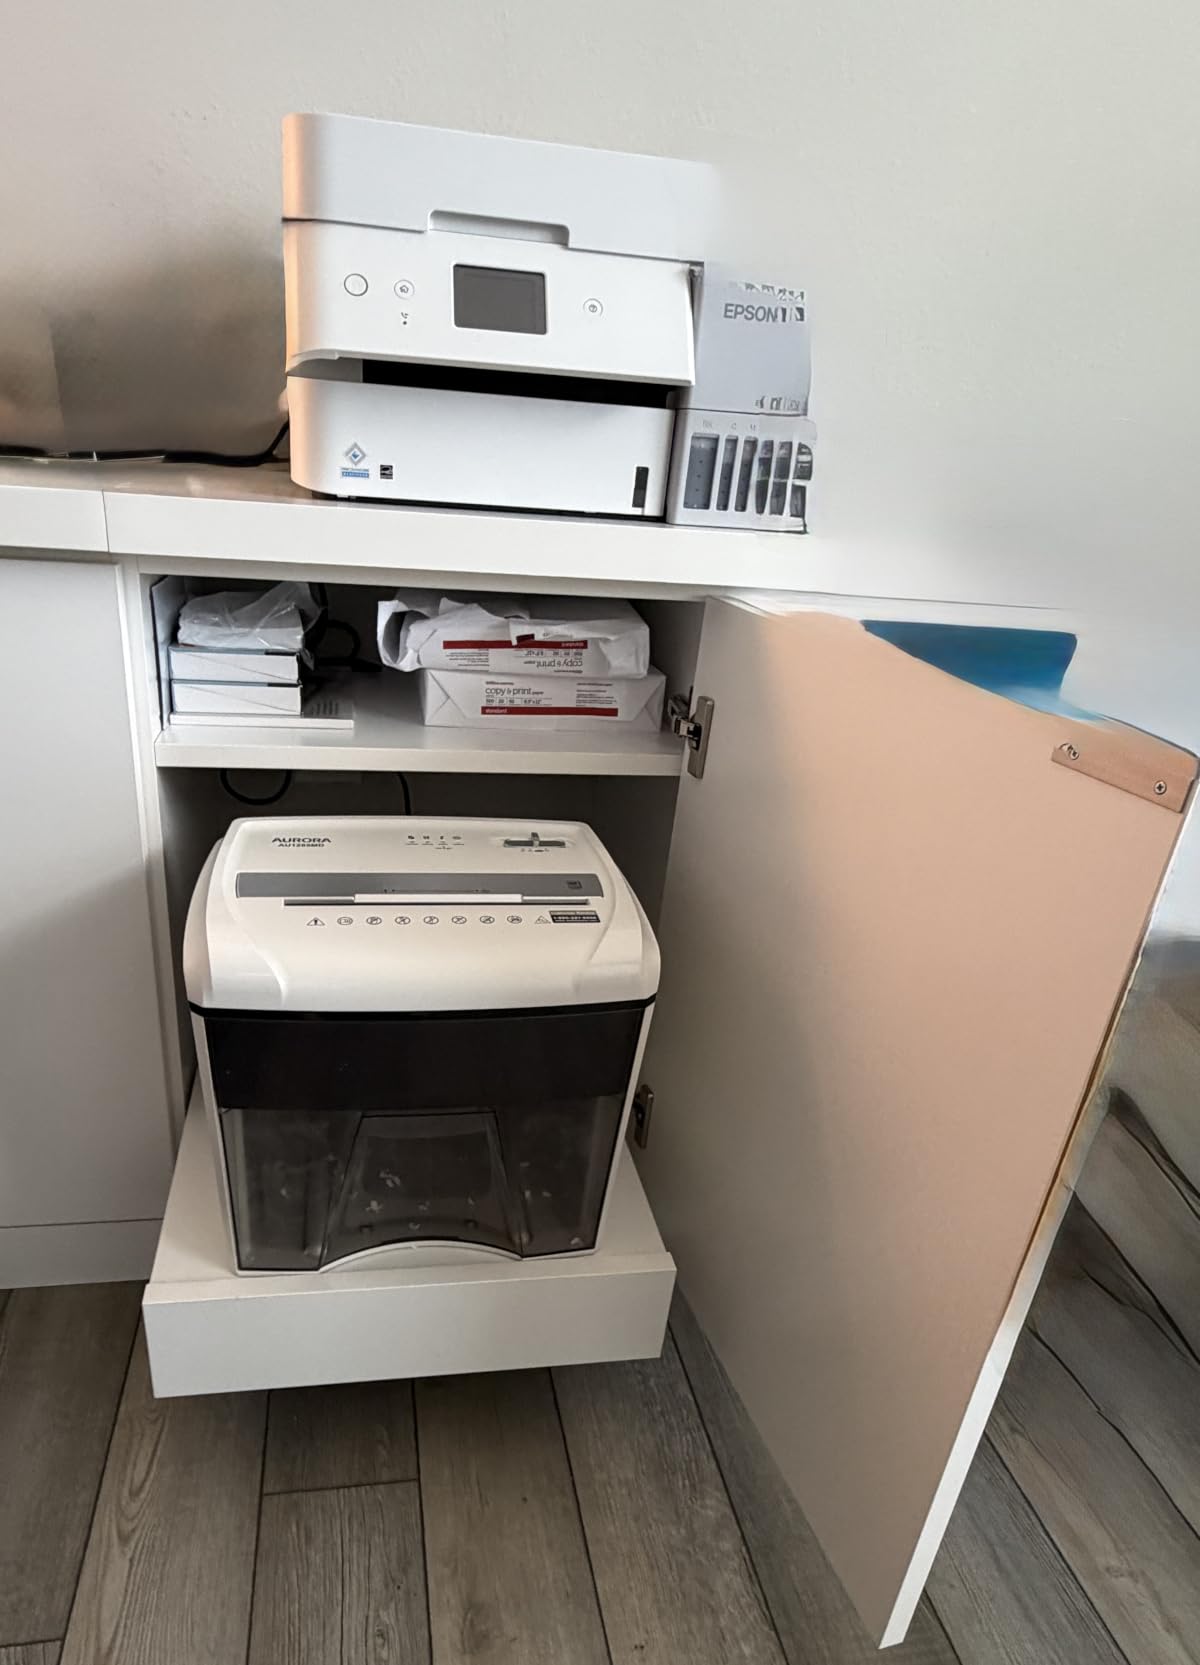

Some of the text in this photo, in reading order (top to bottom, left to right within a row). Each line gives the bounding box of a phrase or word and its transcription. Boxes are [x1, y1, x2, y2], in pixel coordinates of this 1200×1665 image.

[723, 303, 778, 323] EPSON
[536, 659, 555, 668] print
[564, 659, 583, 667] copy
[485, 687, 506, 696] copy
[512, 687, 532, 696] print
